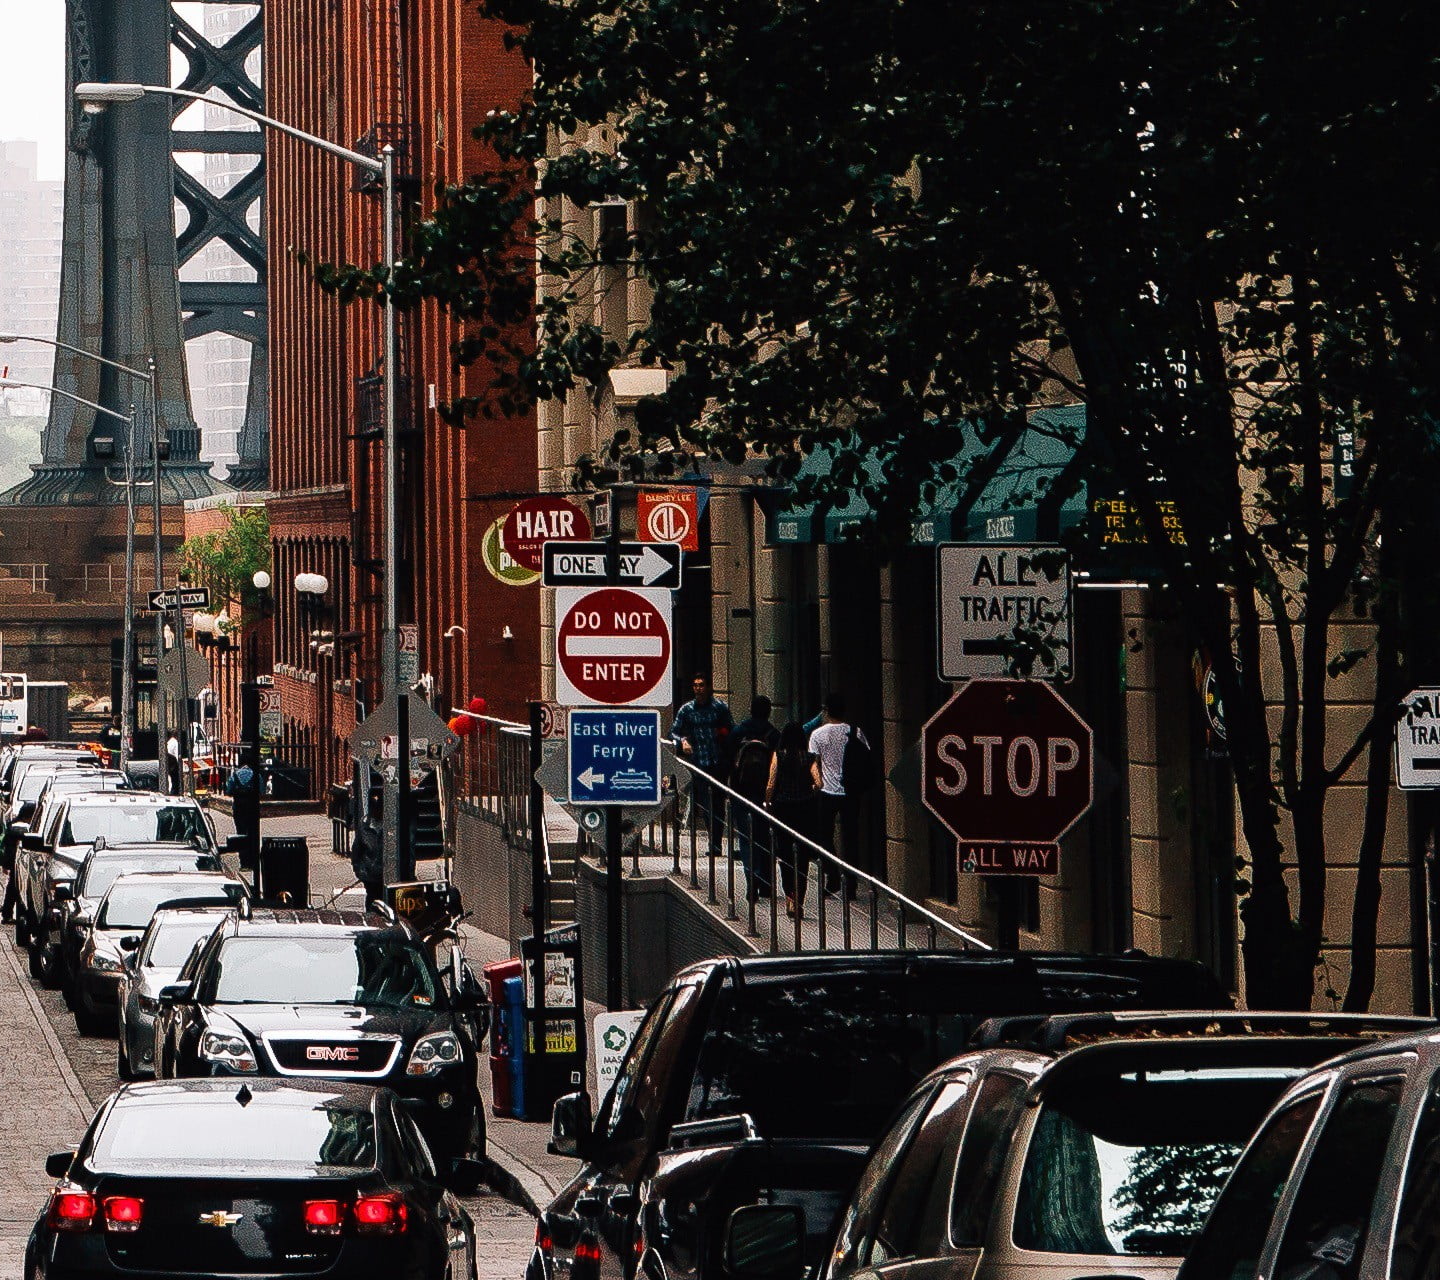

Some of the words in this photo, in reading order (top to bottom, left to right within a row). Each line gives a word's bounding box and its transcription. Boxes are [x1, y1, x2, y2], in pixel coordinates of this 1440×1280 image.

[679, 494, 691, 502] LEE
[516, 510, 576, 539] HAIR
[559, 556, 597, 574] ONE
[603, 556, 640, 574] AY
[972, 555, 1037, 587] ALL
[158, 593, 176, 605] ONE
[183, 593, 202, 604] WAY
[960, 596, 1050, 622] TRAFFIC
[574, 611, 601, 630] DO
[614, 611, 653, 630] NOT
[582, 662, 646, 682] ENTER
[573, 722, 605, 737] East
[615, 722, 655, 737] River
[592, 744, 636, 762] Ferry
[935, 734, 1081, 798] STOP
[968, 847, 1003, 867] ALL
[1012, 848, 1051, 868] WAY
[306, 1045, 360, 1062] GMC
